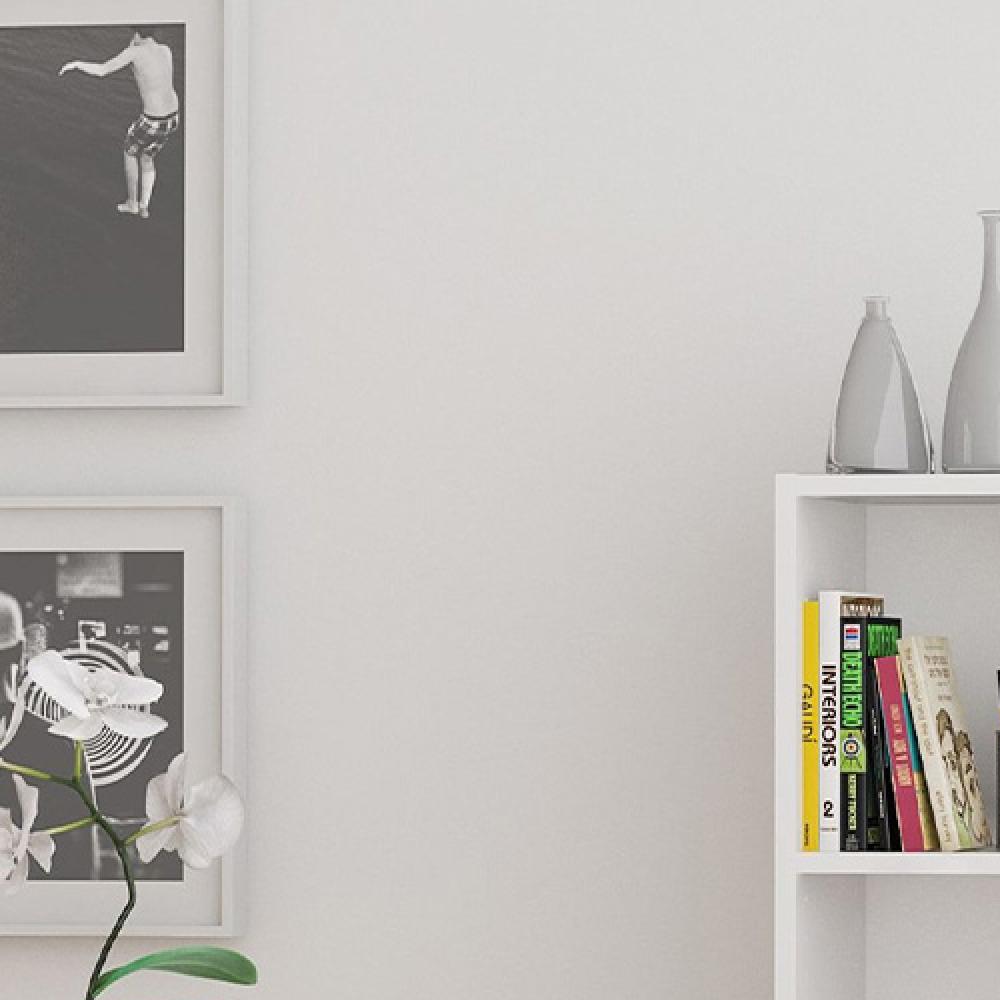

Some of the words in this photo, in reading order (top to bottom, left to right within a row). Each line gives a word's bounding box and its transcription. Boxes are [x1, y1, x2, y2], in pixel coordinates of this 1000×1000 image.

[842, 652, 862, 692] DEATH
[822, 665, 836, 766] INTERIORS
[842, 694, 862, 727] ECHO
[824, 801, 834, 817] 2
